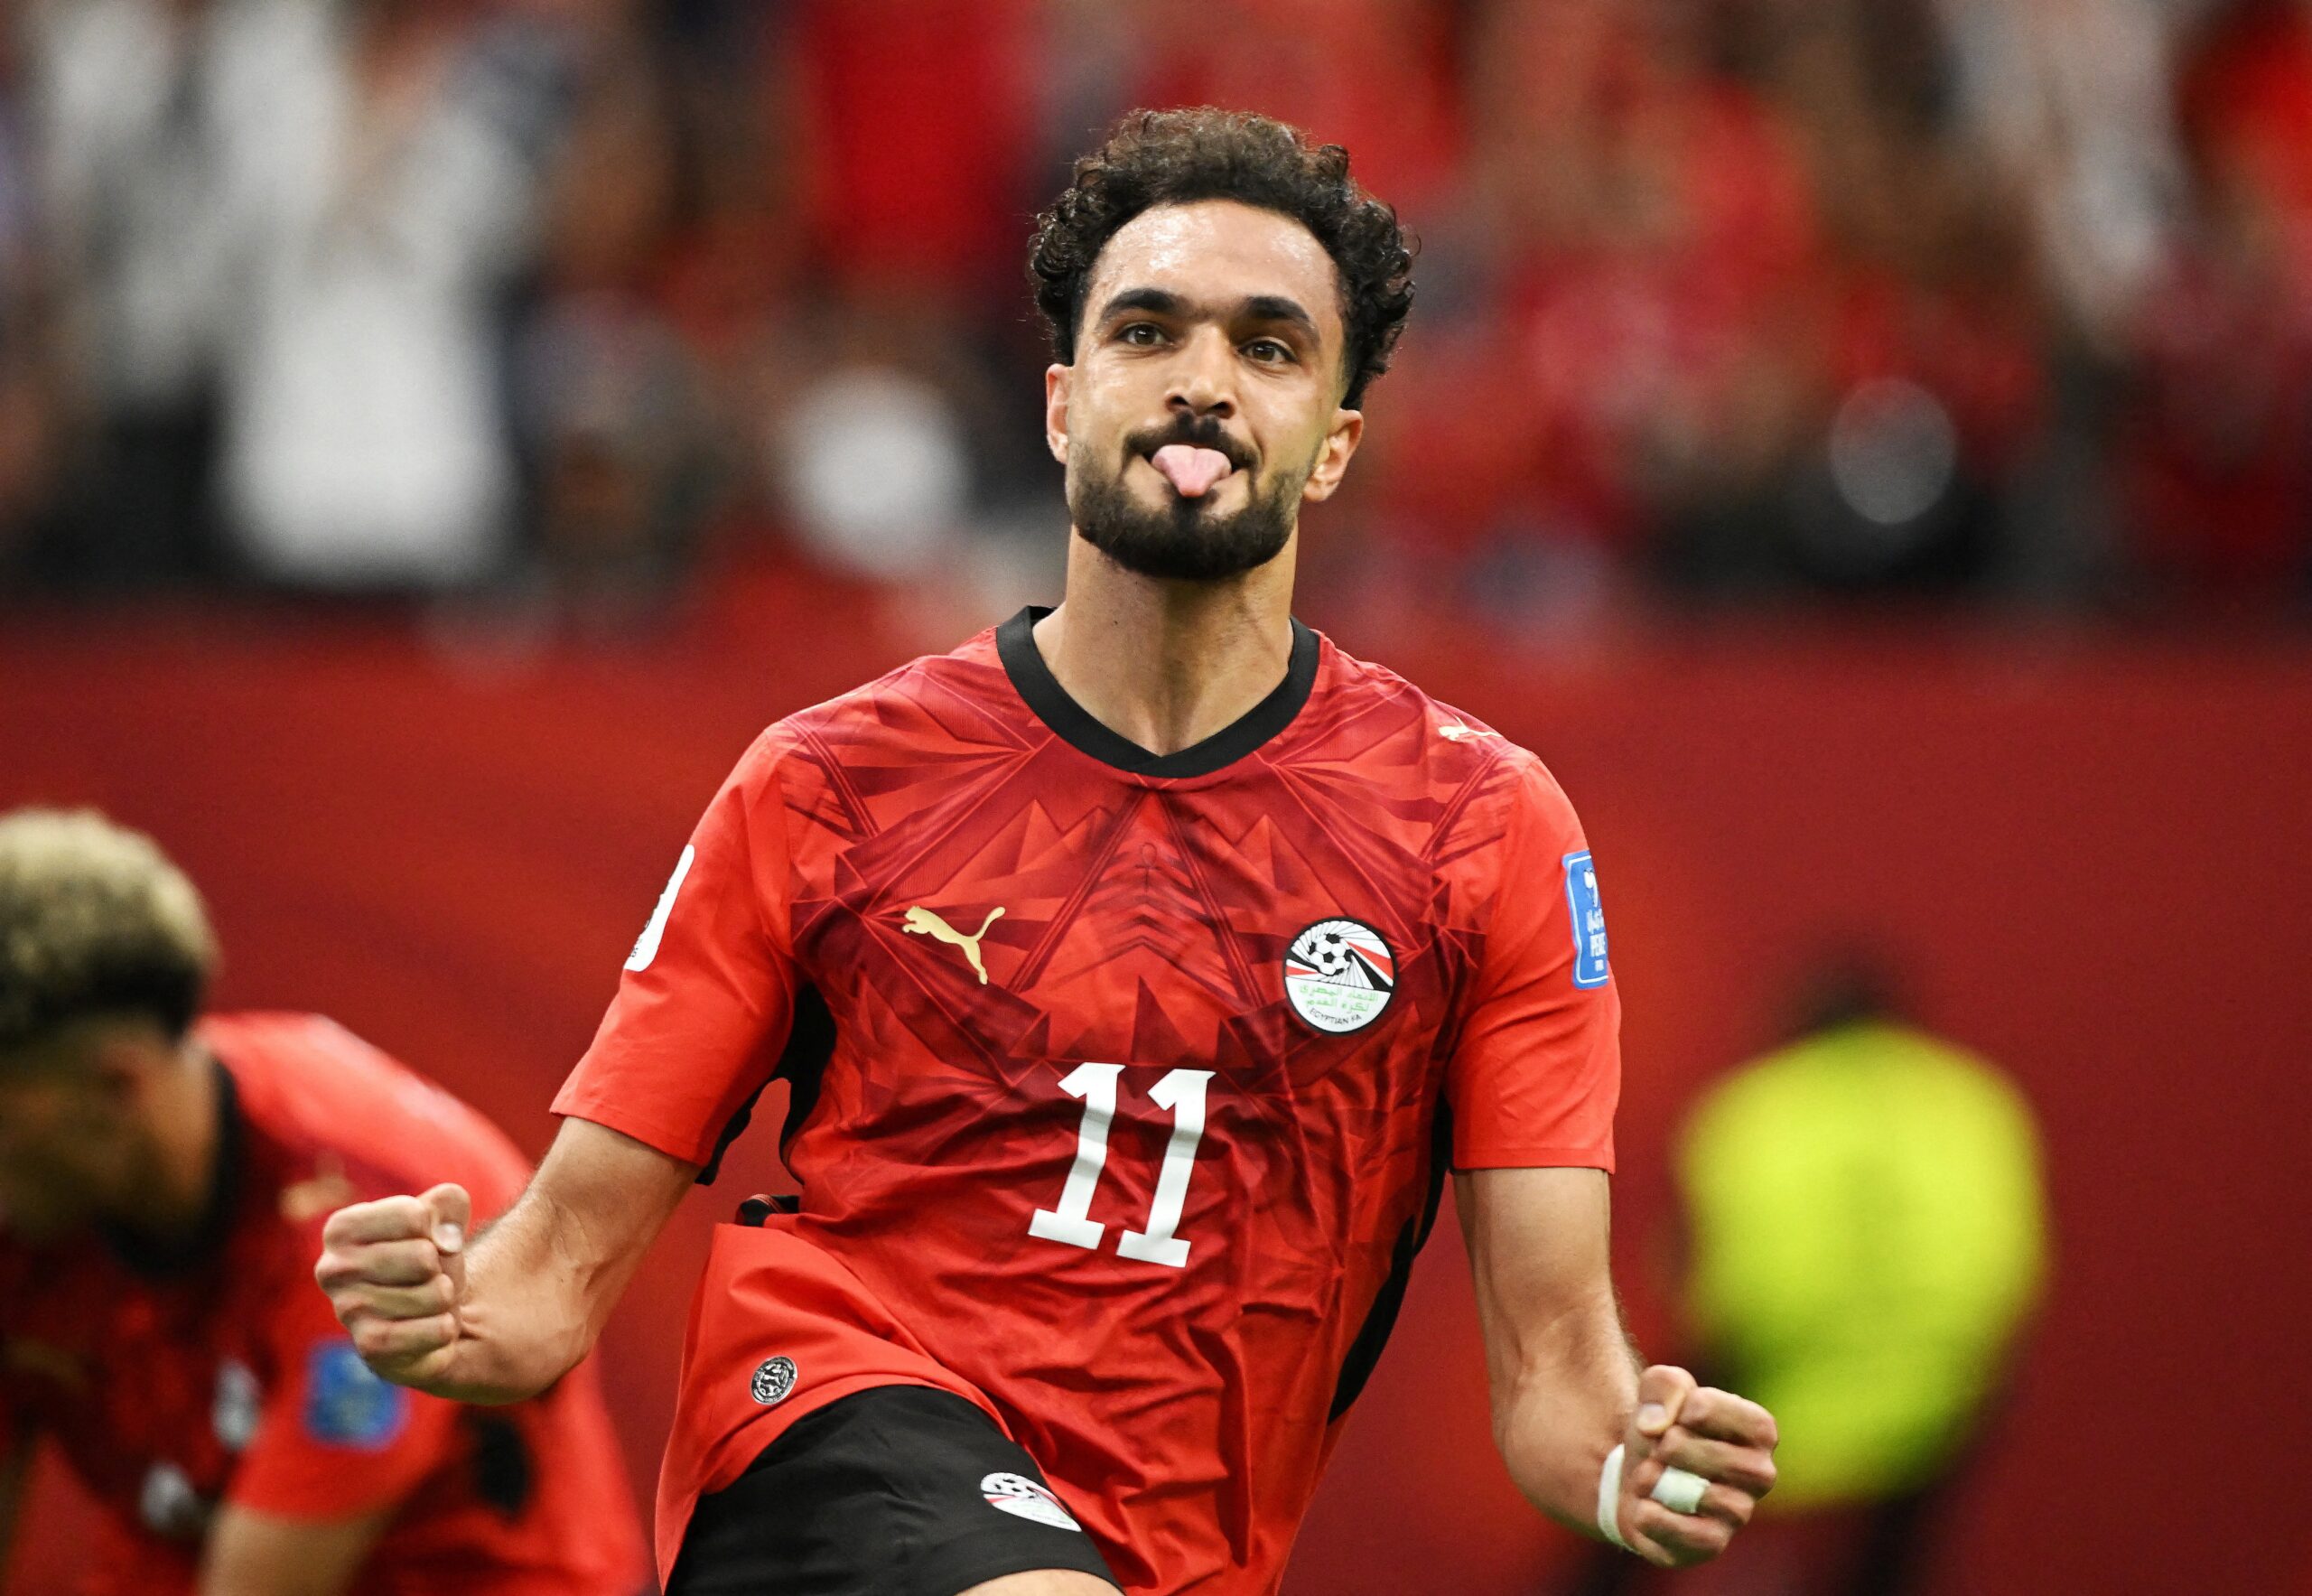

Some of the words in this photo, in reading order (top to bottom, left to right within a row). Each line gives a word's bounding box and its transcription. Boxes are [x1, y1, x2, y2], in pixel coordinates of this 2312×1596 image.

[1310, 1008, 1348, 1024] EGYPTIAN
[1351, 1014, 1362, 1022] FA
[1028, 1062, 1217, 1267] 11
